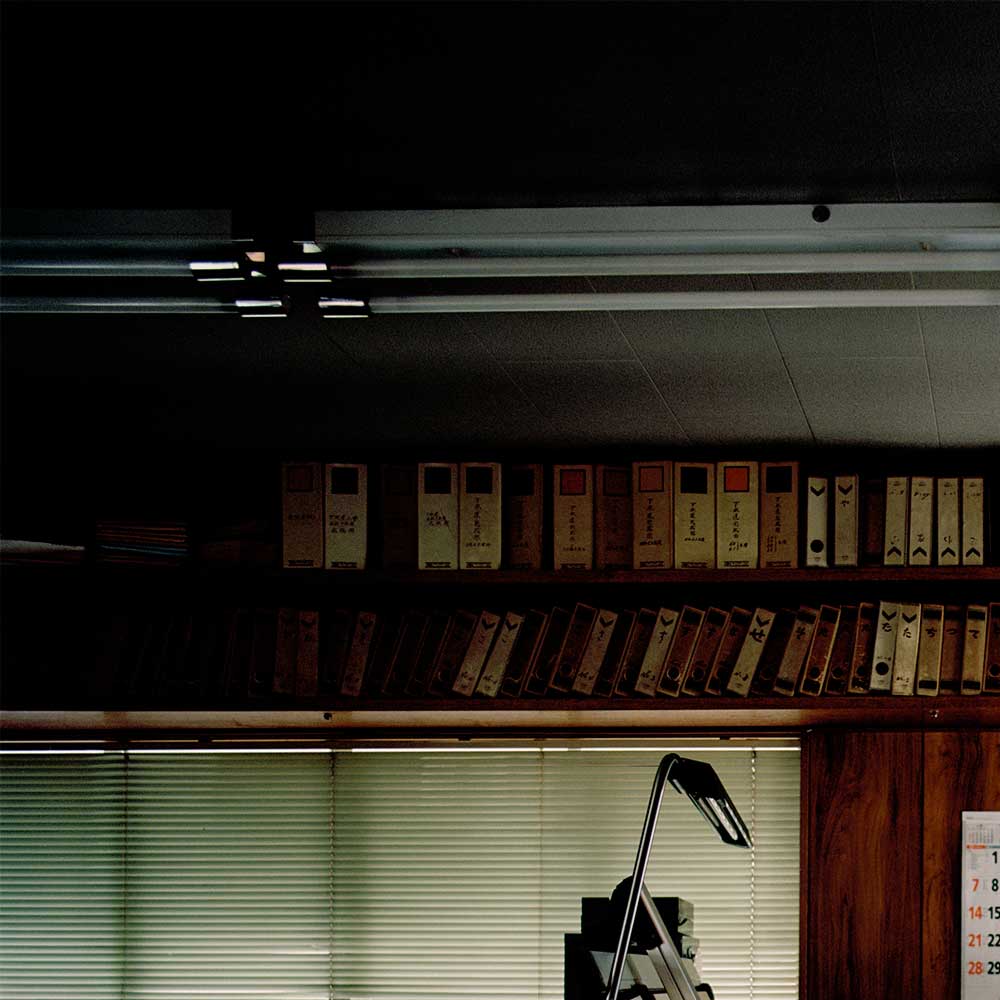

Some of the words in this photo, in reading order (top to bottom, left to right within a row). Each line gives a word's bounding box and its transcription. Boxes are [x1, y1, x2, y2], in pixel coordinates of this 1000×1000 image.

[882, 622, 892, 633] た
[903, 627, 912, 639] た
[750, 627, 766, 643] せ
[992, 851, 997, 864] 1
[972, 879, 979, 892] 7
[992, 879, 999, 892] 8
[969, 906, 982, 919] 14
[988, 907, 1000, 919] 15
[968, 934, 981, 947] 21
[988, 934, 1000, 947] 22
[968, 962, 983, 975] 28
